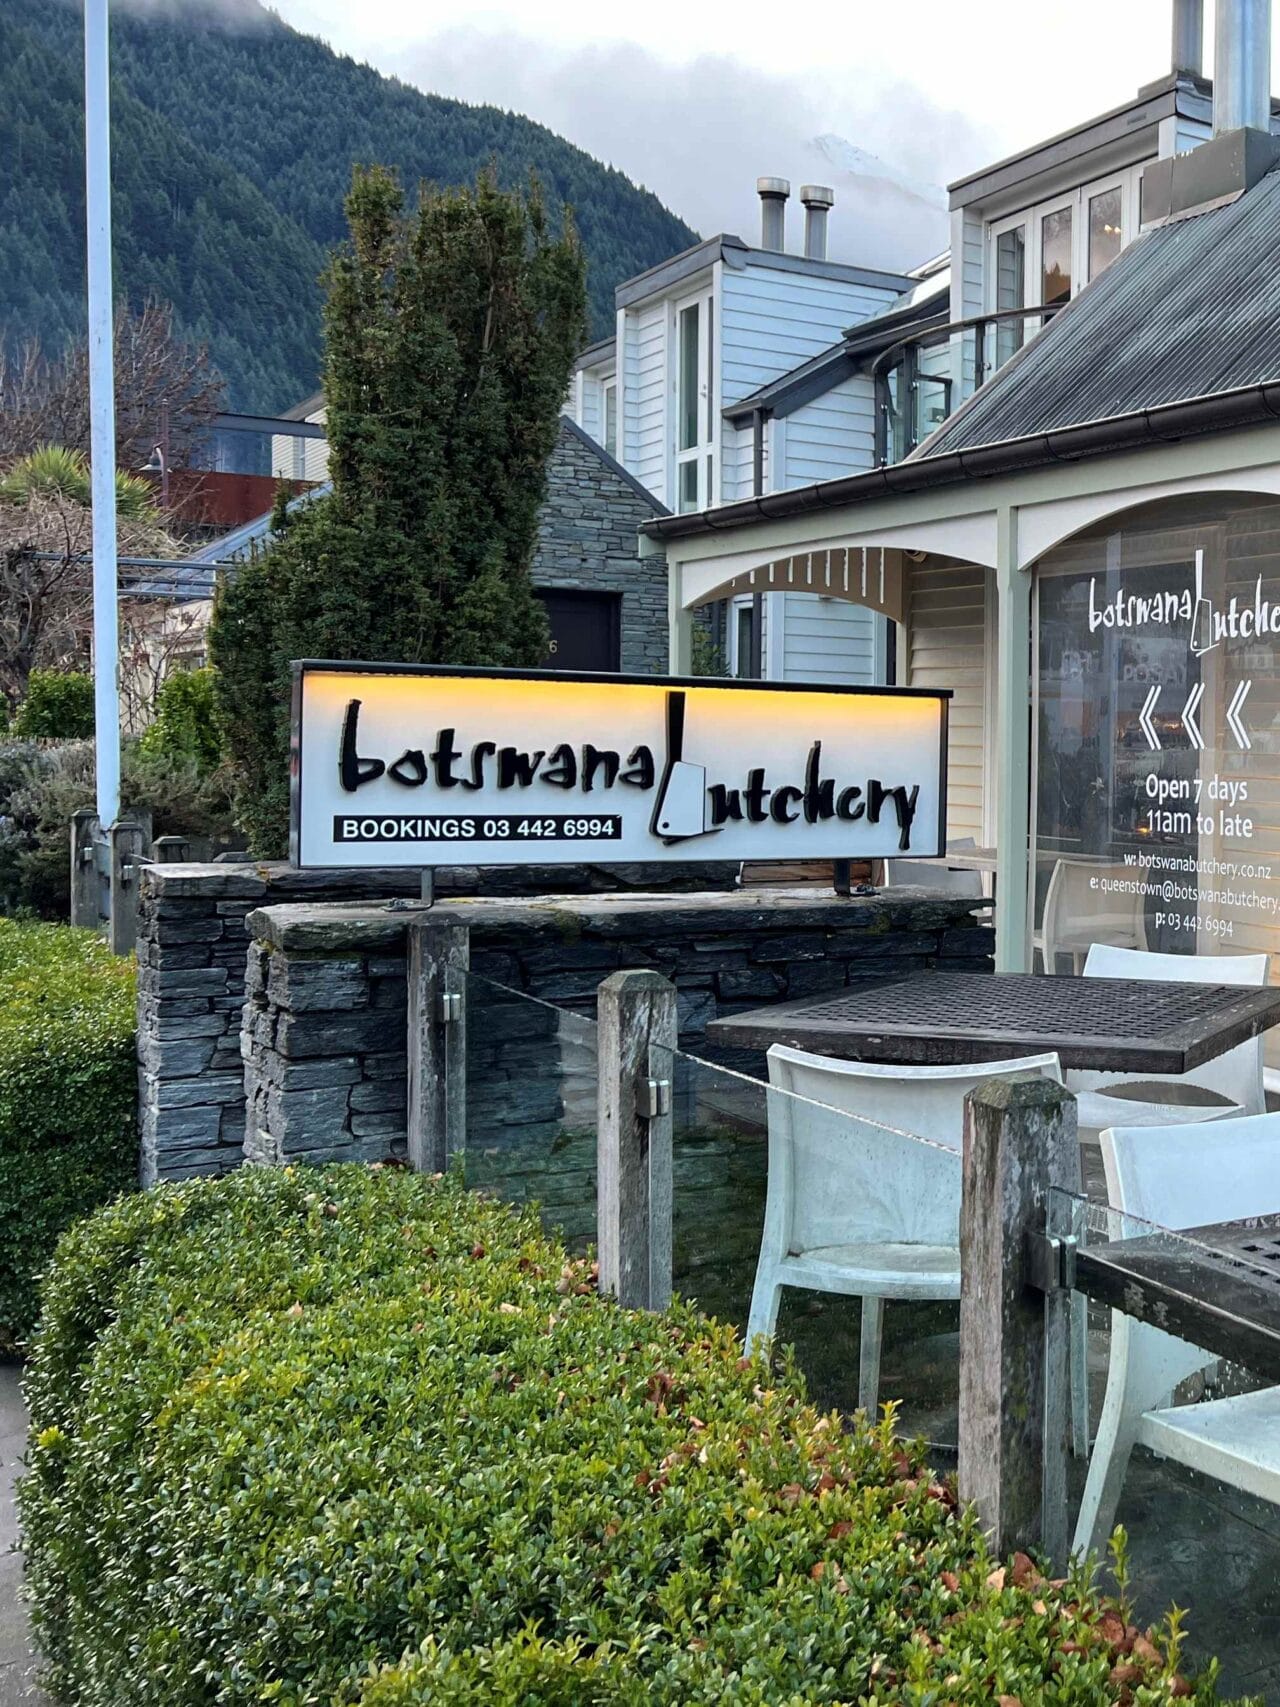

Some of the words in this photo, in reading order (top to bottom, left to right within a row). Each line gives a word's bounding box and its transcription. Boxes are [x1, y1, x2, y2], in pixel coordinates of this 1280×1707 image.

[1088, 577, 1192, 633] botswana
[549, 639, 558, 654] 6
[339, 698, 655, 792] botswana
[1146, 773, 1190, 805] Open
[1193, 779, 1203, 804] 7
[1207, 773, 1248, 807] days
[342, 819, 475, 839] BOOKINGS
[483, 820, 510, 837] 03
[517, 820, 557, 837] 442
[563, 819, 614, 837] 6994
[1146, 808, 1191, 834] 11am
[1196, 811, 1215, 836] to
[1219, 810, 1253, 838] late
[1123, 854, 1137, 867] w:
[1138, 850, 1271, 881] botswanabutchery.co.nz
[1090, 877, 1099, 890] e:
[1155, 912, 1166, 929] p:
[1167, 913, 1181, 931] 03
[1183, 915, 1203, 933] 442
[1204, 916, 1234, 937] 6994
